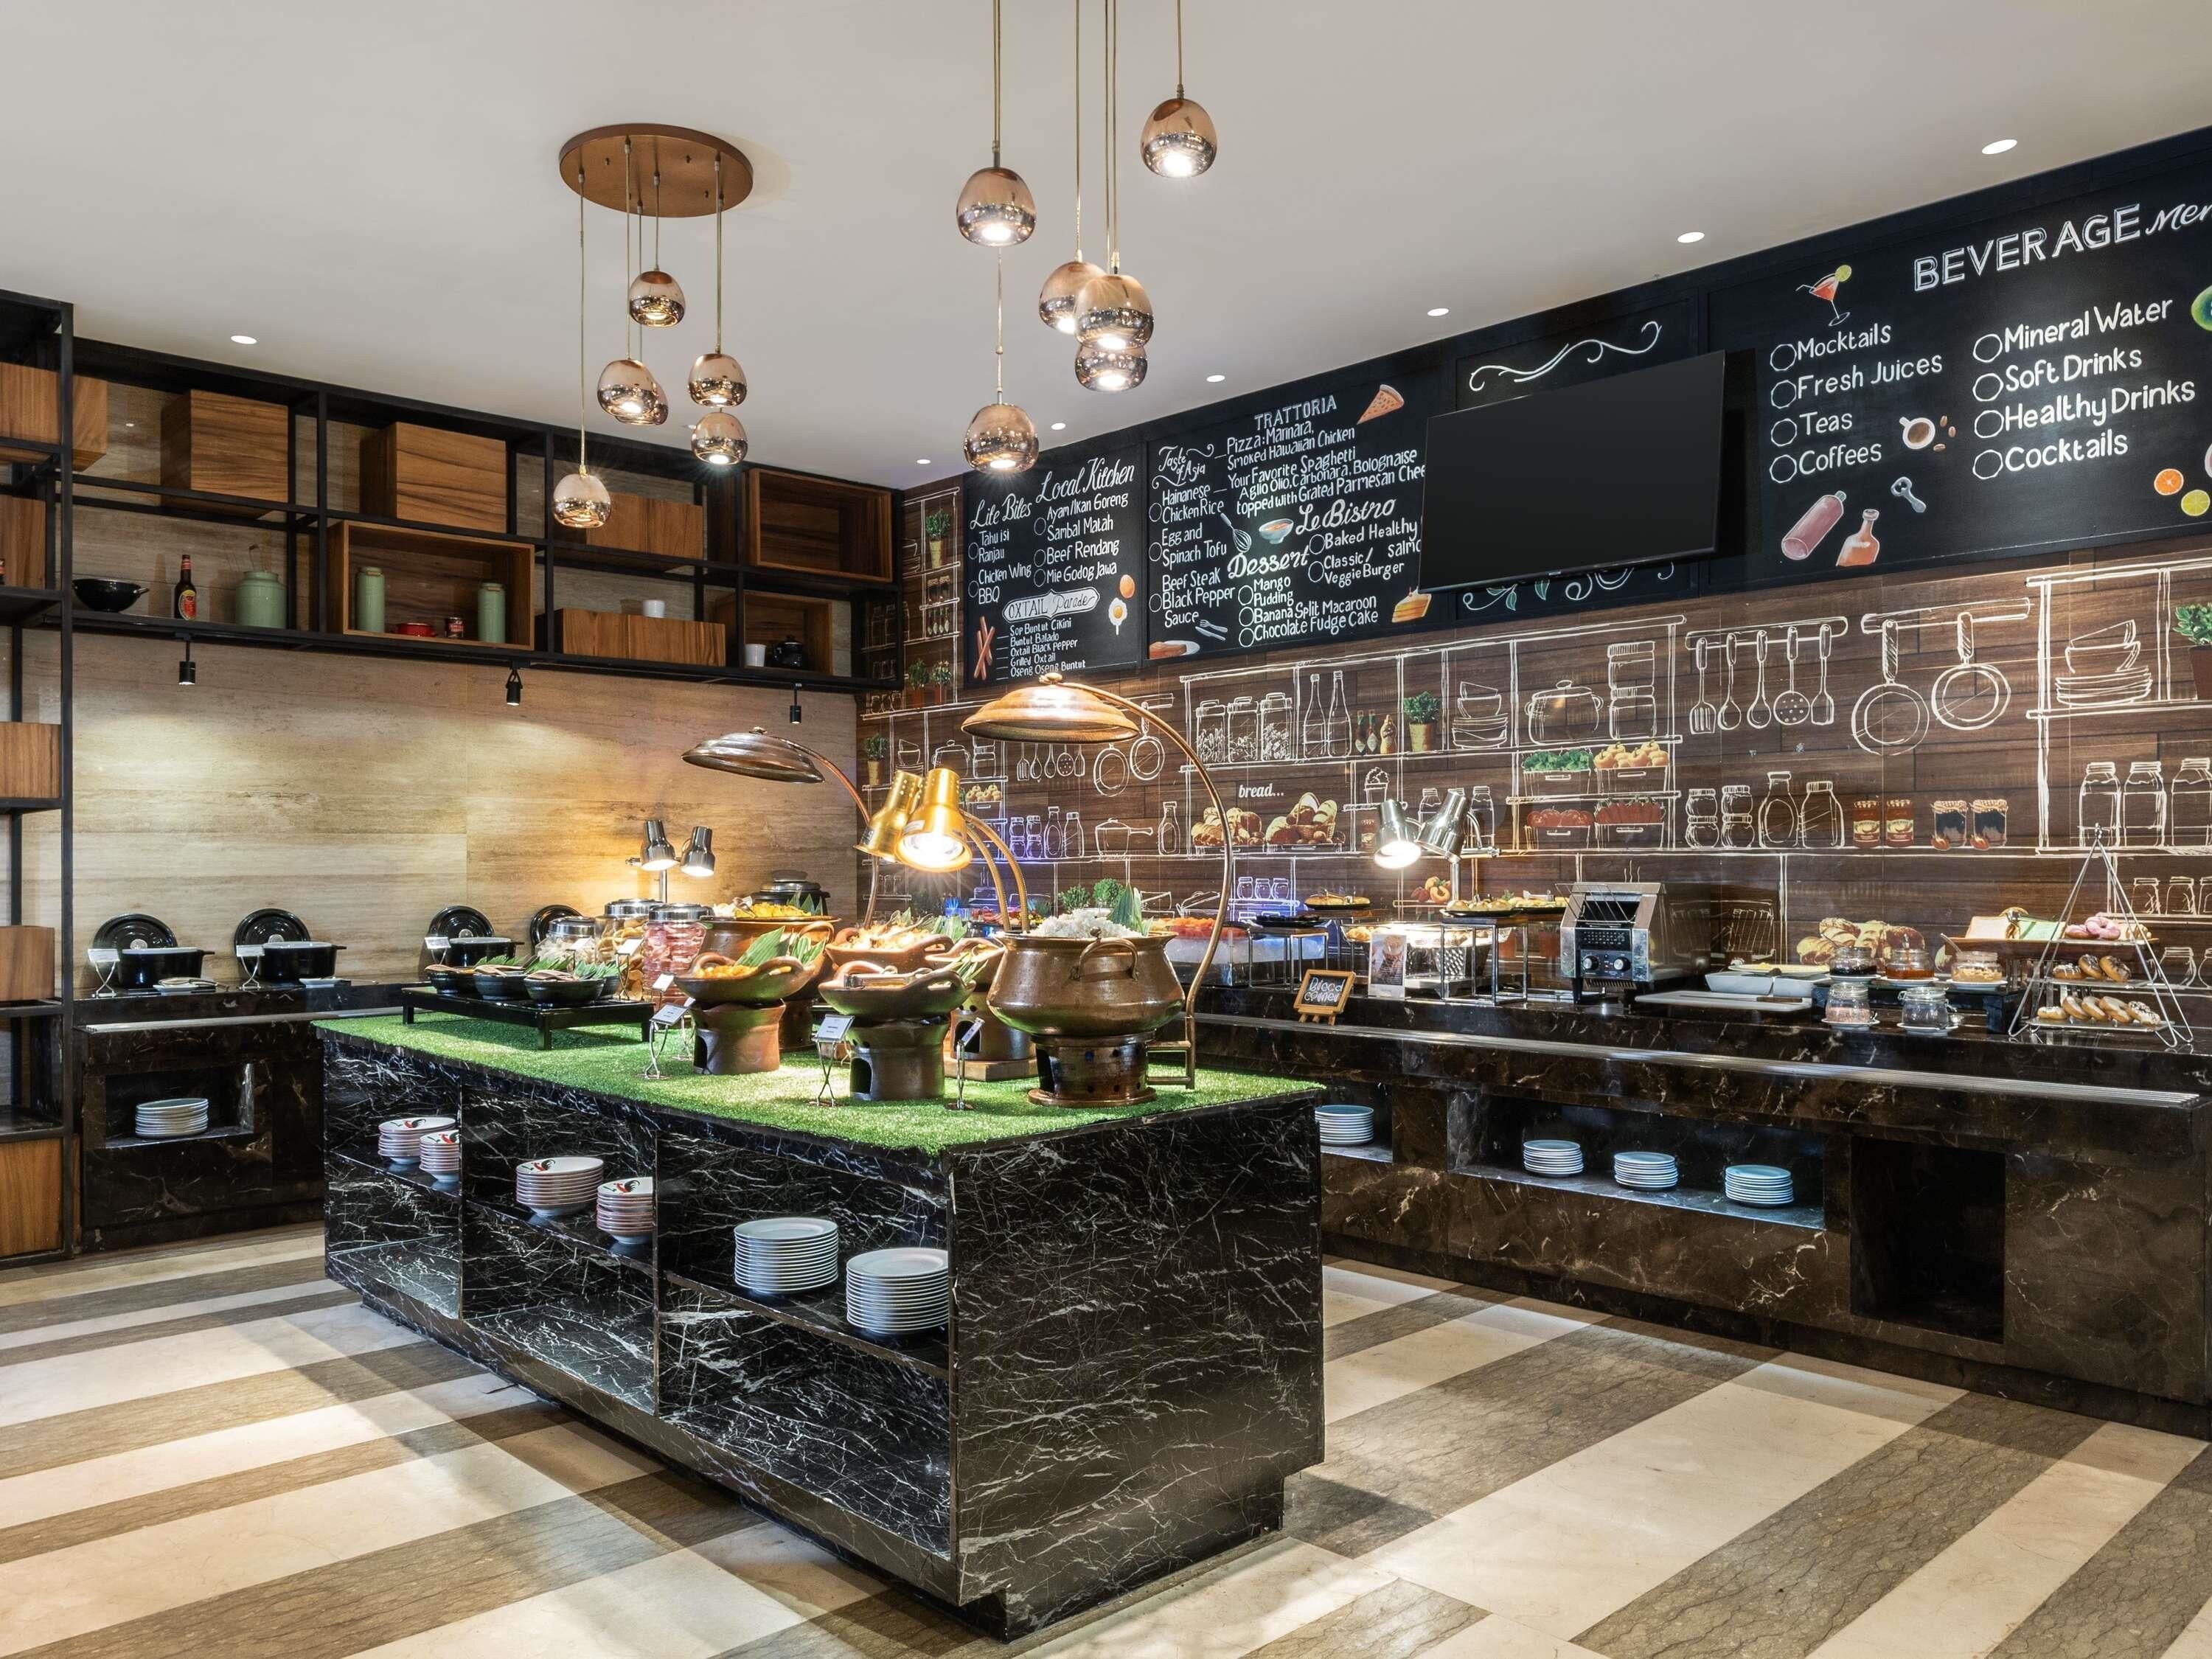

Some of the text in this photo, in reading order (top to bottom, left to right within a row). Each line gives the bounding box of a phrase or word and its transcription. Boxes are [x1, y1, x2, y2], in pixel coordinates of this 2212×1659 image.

[1913, 203, 2140, 292] BEVERAGE
[2003, 298, 2173, 354] Mineral Water
[1796, 321, 1892, 362] Mocktails
[1796, 354, 1944, 402] Fresh Juices
[2004, 347, 2143, 392] Soft Drinks
[1253, 394, 1338, 431] TRATTORIA
[2003, 380, 2197, 432] Healthy Drinks
[1799, 411, 1853, 438] Teas
[1158, 445, 1186, 472] Taste
[1227, 435, 1265, 455] Pizza:
[1227, 448, 1267, 471] Smoked
[1269, 437, 1315, 460] Hawaiian
[2004, 431, 2129, 472] Cocktails
[1228, 446, 1356, 490] Your Favorite Spaghetti
[1798, 442, 1882, 476] Coffees
[1035, 457, 1135, 504] Local Kitchen
[1176, 460, 1206, 486] of Asia
[1239, 483, 1269, 501] Aglio
[1353, 449, 1418, 475] Bolognaise
[1093, 493, 1129, 510] Goreng
[1163, 484, 1211, 507] Hainanese
[1237, 499, 1274, 518] topped
[1275, 491, 1298, 507] with
[1298, 481, 1334, 503] Grated
[1336, 470, 1395, 495] Parmesan
[970, 493, 1032, 530] Lite Bites
[1163, 498, 1224, 524] Chicken Rice
[1295, 498, 1397, 535] Le Bistro
[978, 528, 1010, 546] Tahu isi
[1047, 513, 1114, 541] Sambal Matah
[1161, 522, 1203, 547] Egg and
[1325, 517, 1418, 549] Baked Healthy
[978, 548, 1005, 563] Ranjau
[1046, 538, 1120, 565] Beef Rendang
[1162, 540, 1227, 571] Spinach Tofu
[1227, 545, 1310, 580] Dessert
[1008, 564, 1032, 579] Wing
[1046, 561, 1118, 584] Mie Godog Jawa
[1162, 567, 1221, 592] Beef Steak
[1253, 576, 1291, 592] Mango
[1324, 563, 1405, 588] Veggie Burger
[978, 586, 1001, 605] BBQ
[1009, 594, 1095, 619] OXTAIL Parade
[1162, 587, 1236, 610] Black Pepper
[1253, 591, 1294, 607] Pudding
[1164, 610, 1199, 628] Sauce
[1253, 595, 1377, 624] Banana Split Macaroon
[1010, 625, 1023, 636] Sop
[1010, 631, 1060, 647] Buntut Balado
[1253, 611, 1379, 641] Chocolate Fudge Cake
[1010, 646, 1030, 657] Oxtail
[1034, 653, 1056, 664] Oxtail
[1061, 659, 1086, 672] Buntut
